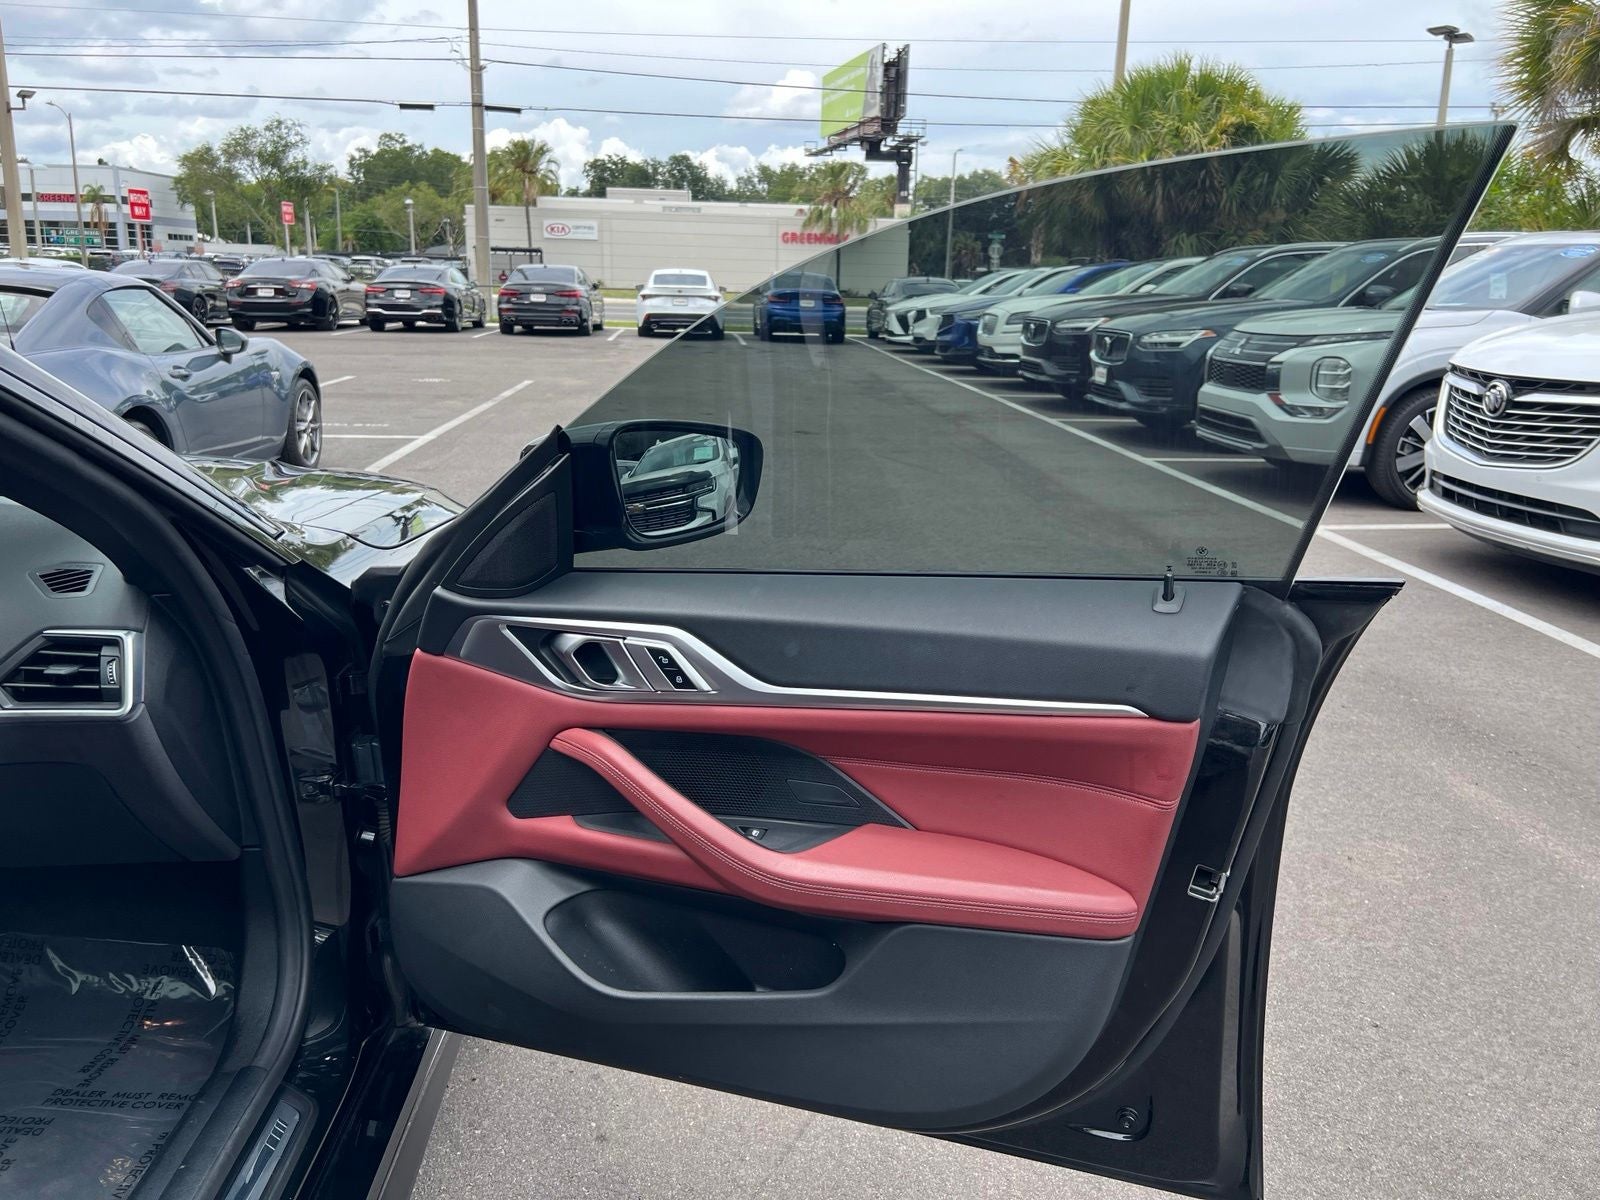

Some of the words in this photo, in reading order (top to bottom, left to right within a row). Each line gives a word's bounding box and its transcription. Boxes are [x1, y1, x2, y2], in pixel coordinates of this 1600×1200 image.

[37, 192, 86, 203] GREENW
[129, 193, 149, 204] WRONG
[133, 206, 147, 216] WAY
[550, 225, 567, 234] KIA
[77, 1048, 113, 1074] COVER
[76, 1057, 120, 1088] REMOVE
[50, 1088, 107, 1098] DEALER
[112, 1091, 152, 1100] MUST
[157, 1092, 197, 1102] REMO
[40, 1098, 129, 1109] PROTECTIVE
[131, 1101, 185, 1111] COVER
